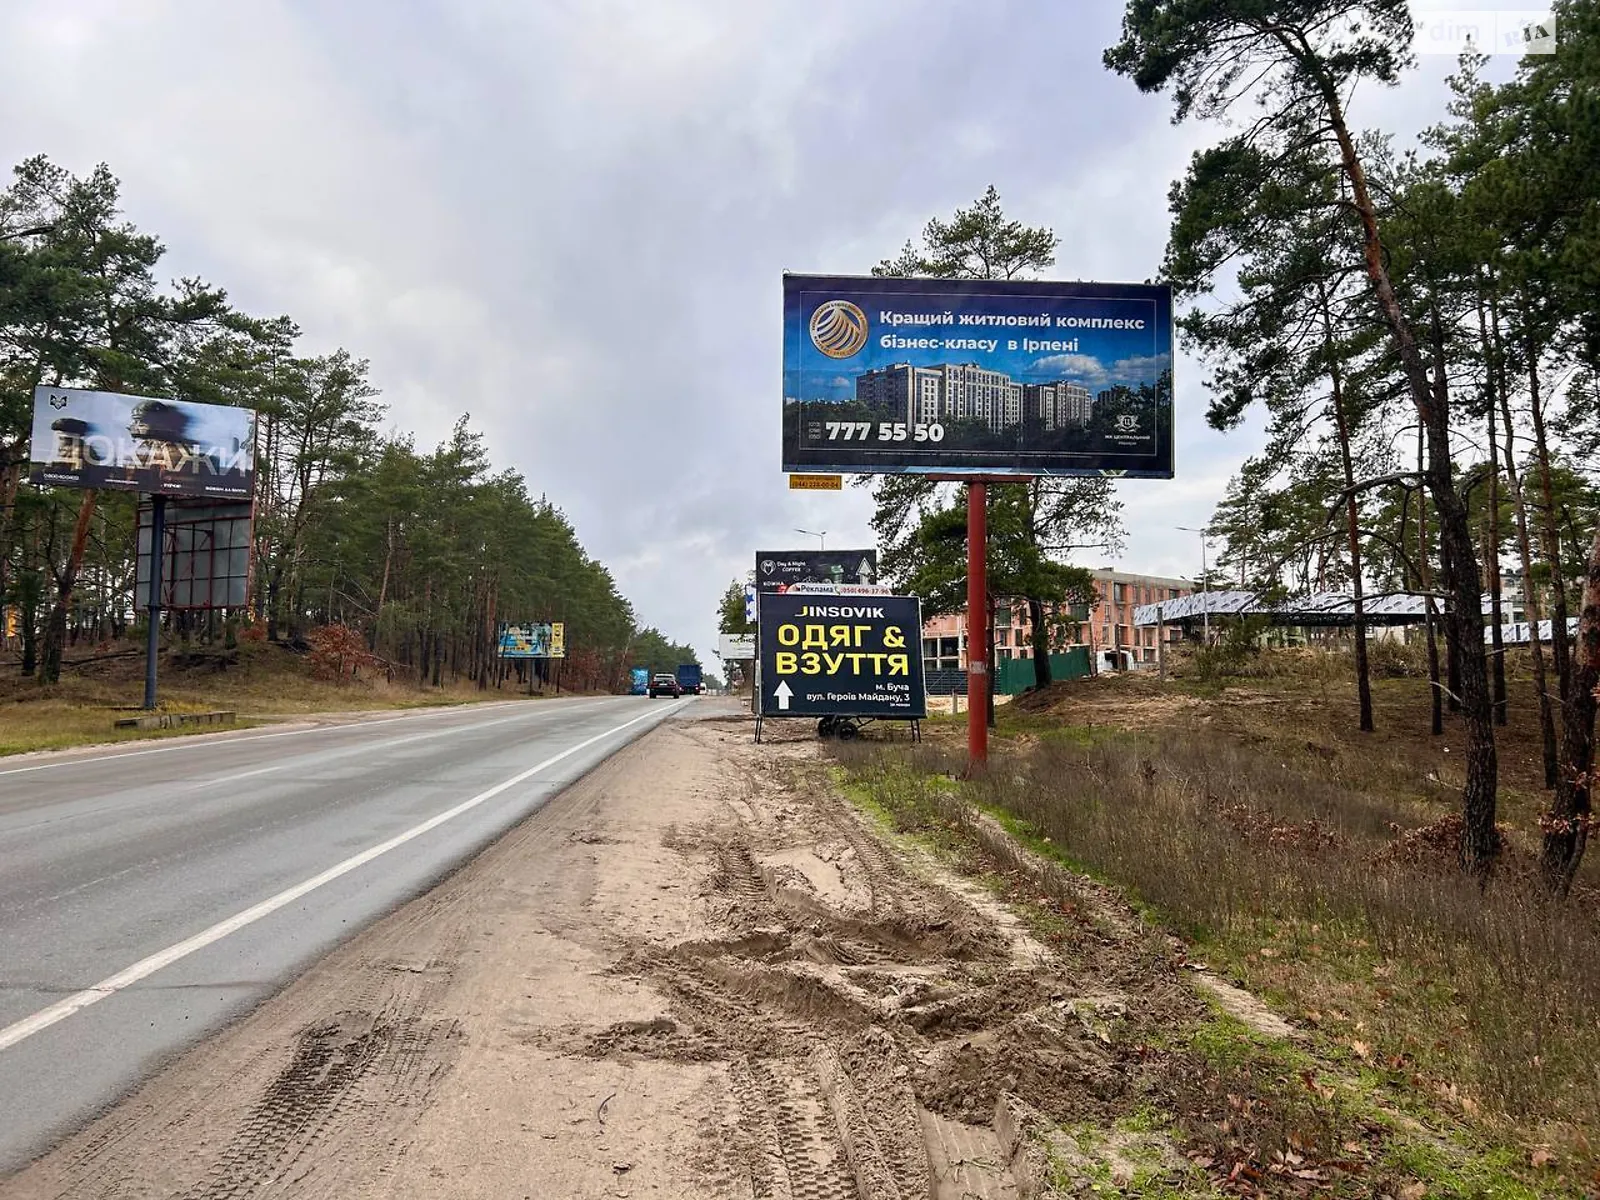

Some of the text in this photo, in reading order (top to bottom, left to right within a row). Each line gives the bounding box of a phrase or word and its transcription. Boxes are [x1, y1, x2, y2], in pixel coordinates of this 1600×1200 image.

[880, 311, 1145, 330] Кращий житловий комплекс
[880, 334, 1079, 353] бізнес-класу в Ірпені
[825, 422, 945, 442] 777 55 50
[50, 430, 249, 478] ДОКАЖИ
[801, 585, 834, 593] Реклама
[794, 605, 884, 618] JINSOVIK
[778, 624, 906, 650] ОДЯГ &
[776, 652, 909, 675] ВЗУТТЯ
[887, 682, 910, 692] Буча
[806, 692, 910, 703] вул. Героїв Майдану, 3
